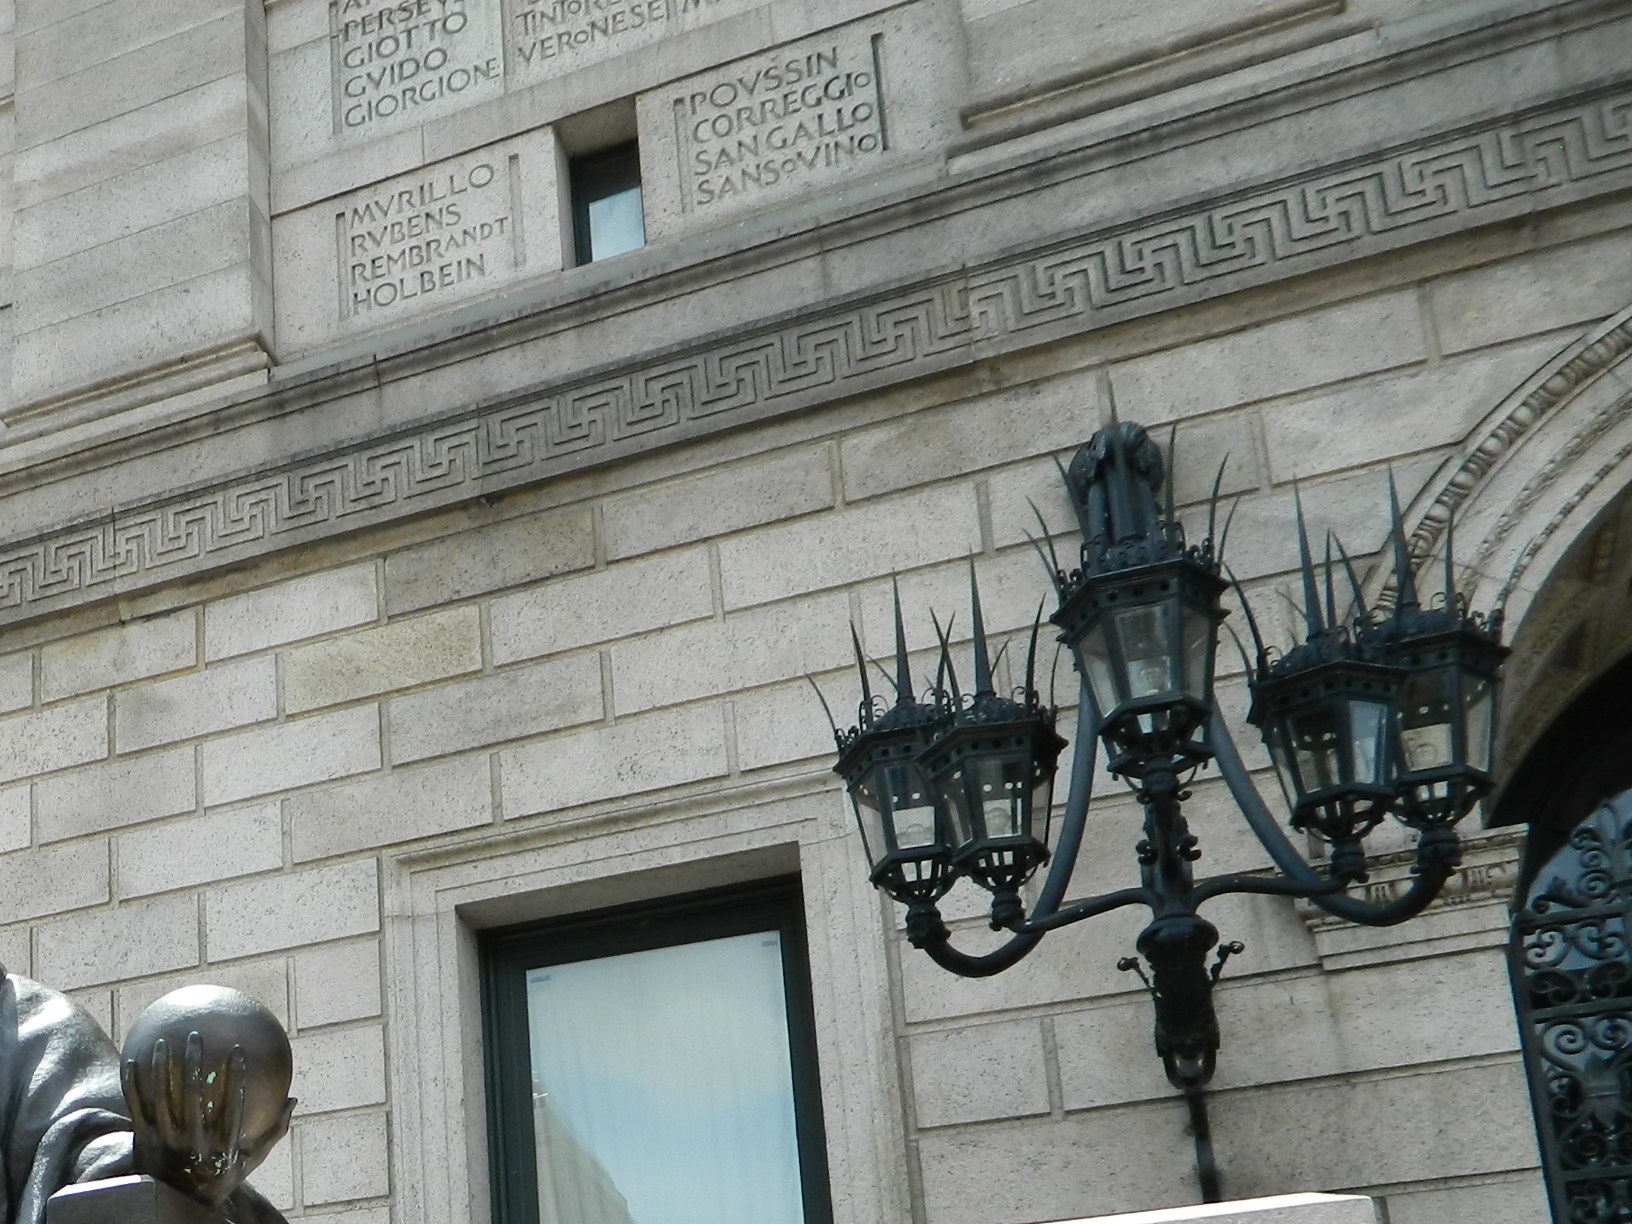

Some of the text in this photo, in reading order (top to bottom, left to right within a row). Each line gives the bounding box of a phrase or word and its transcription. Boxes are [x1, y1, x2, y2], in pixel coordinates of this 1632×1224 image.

[343, 11, 467, 69] GIOTTO
[517, 2, 665, 65] VERONESE
[344, 48, 448, 99] GVIDO
[344, 57, 500, 128] GIORGIONE
[690, 46, 837, 115] POVSSIN
[692, 72, 870, 144] CORREGGIO
[351, 164, 494, 229] MVRILLO
[697, 133, 878, 205] SANSOVINO
[351, 203, 461, 257] RVBENS
[351, 217, 508, 286] REMBRANDT
[353, 253, 485, 316] HOLBEIN
